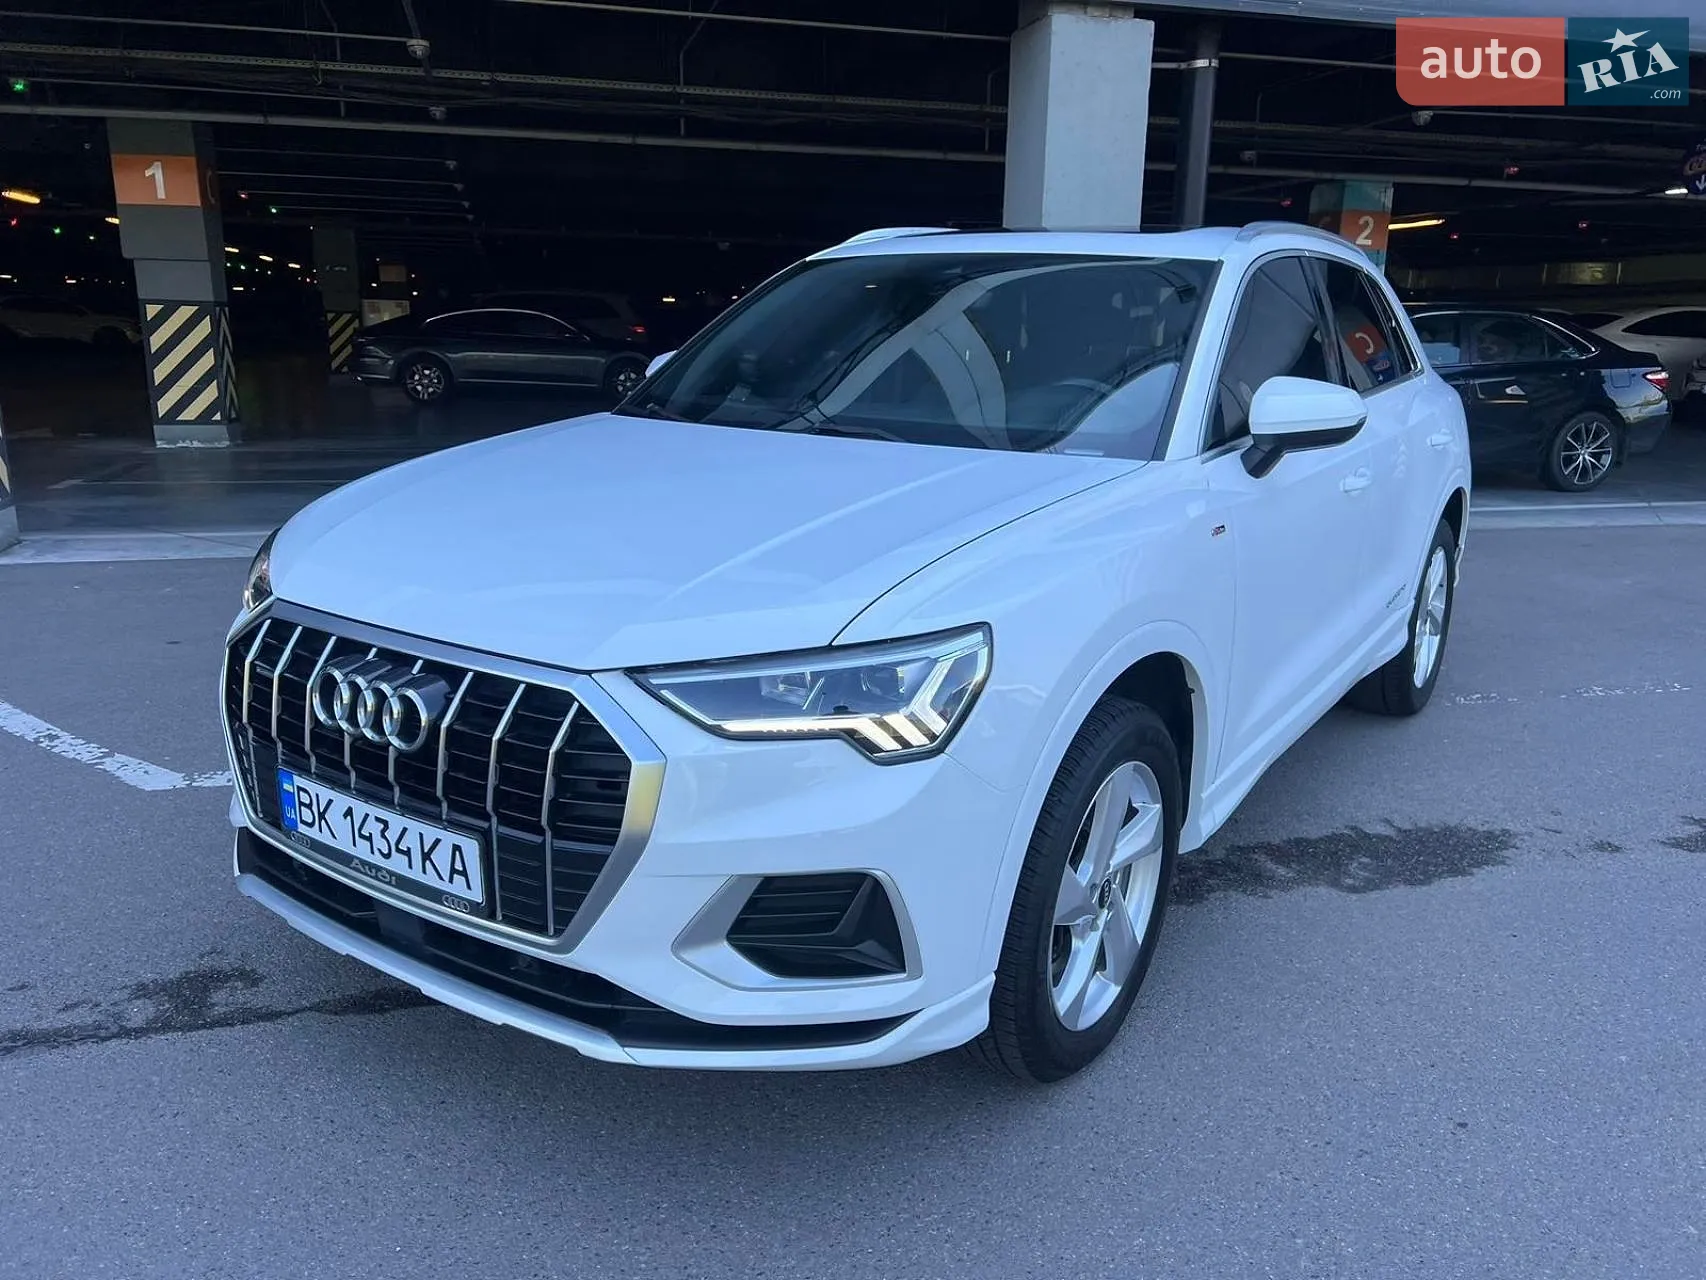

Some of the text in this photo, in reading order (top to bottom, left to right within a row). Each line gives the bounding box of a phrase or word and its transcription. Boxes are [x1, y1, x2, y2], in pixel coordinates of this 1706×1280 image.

[144, 160, 166, 199] 1
[1355, 215, 1374, 246] 2
[285, 806, 296, 821] UA
[296, 785, 472, 891] BK 1434 KA
[349, 858, 397, 886] Audi
